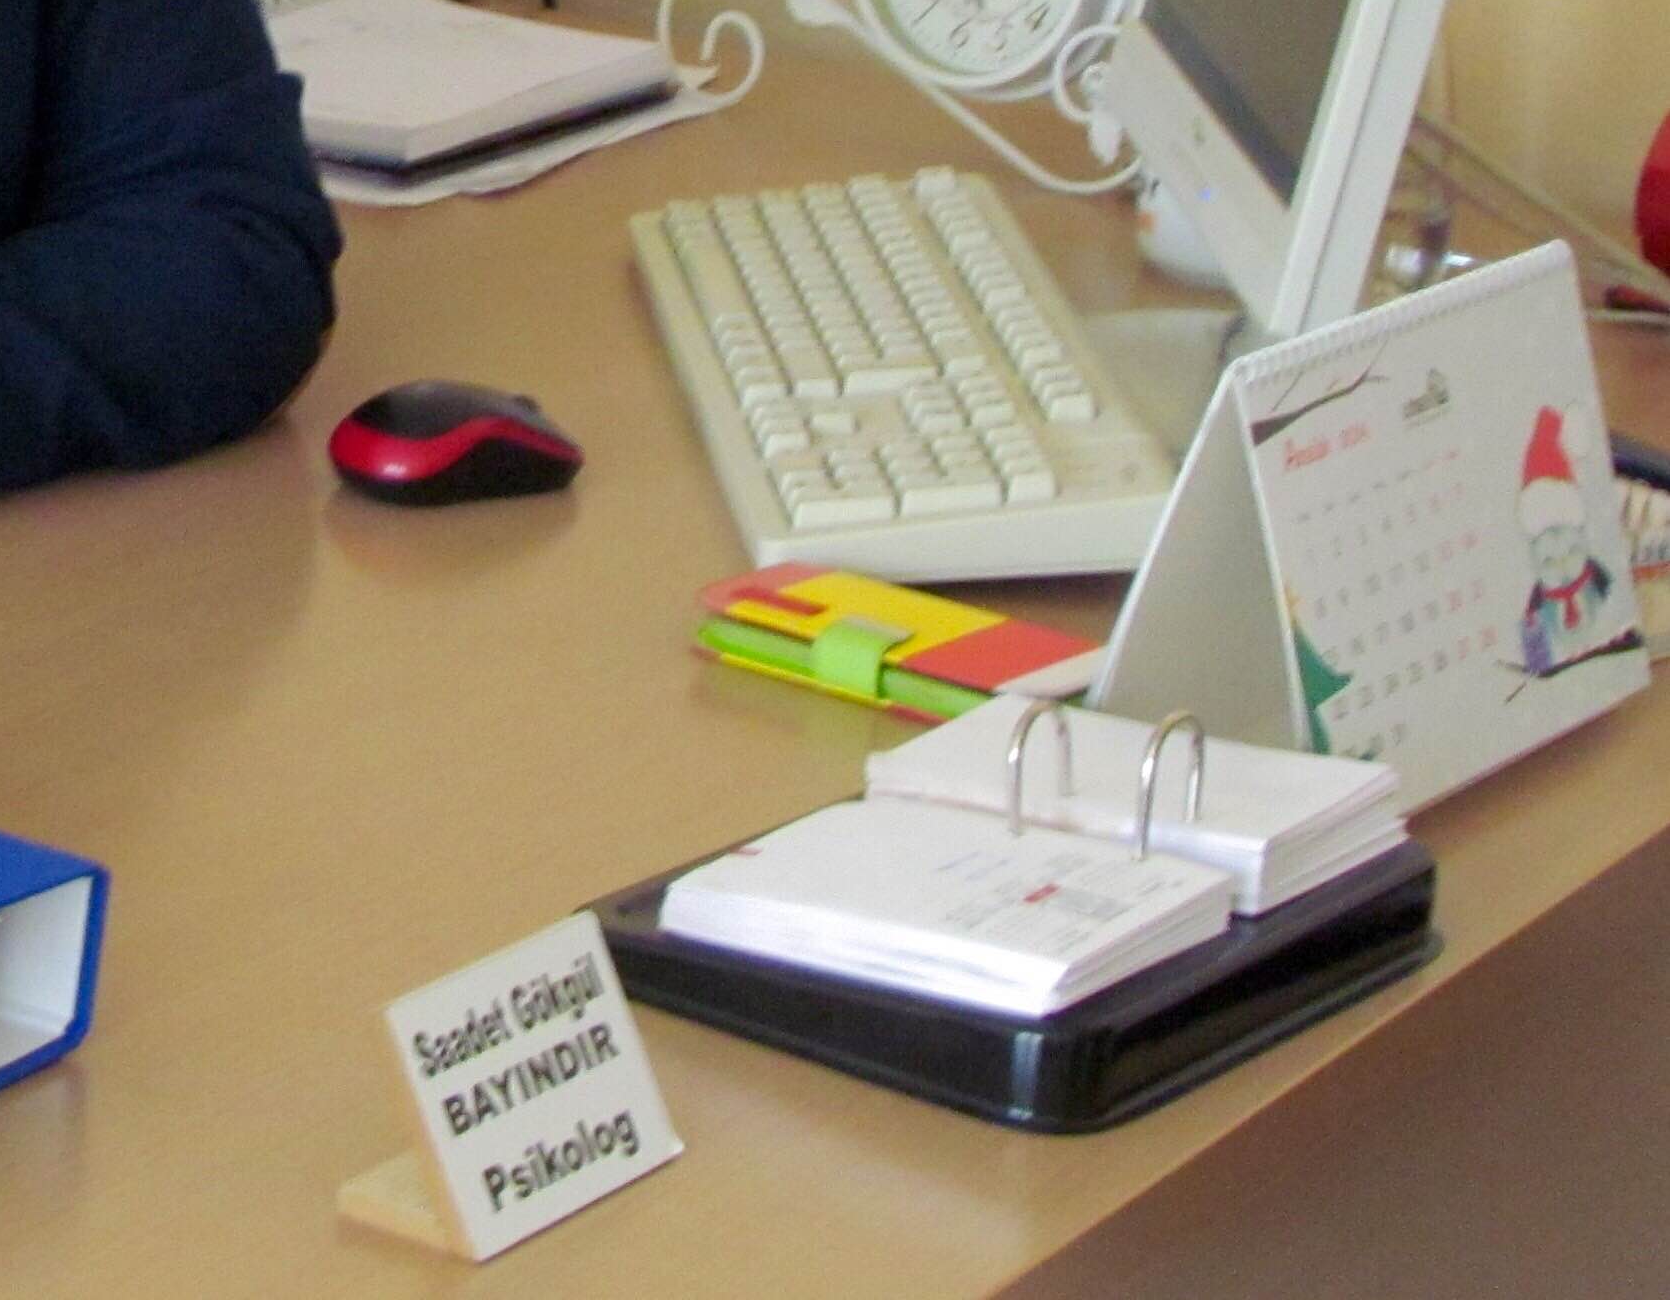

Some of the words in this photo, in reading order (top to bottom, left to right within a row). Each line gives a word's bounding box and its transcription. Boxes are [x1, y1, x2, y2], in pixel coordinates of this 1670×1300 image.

[1023, 1, 1051, 32] 4
[412, 997, 514, 1078] Saadet
[440, 1022, 621, 1137] BAYINDIR
[481, 1110, 640, 1214] Psikolog
